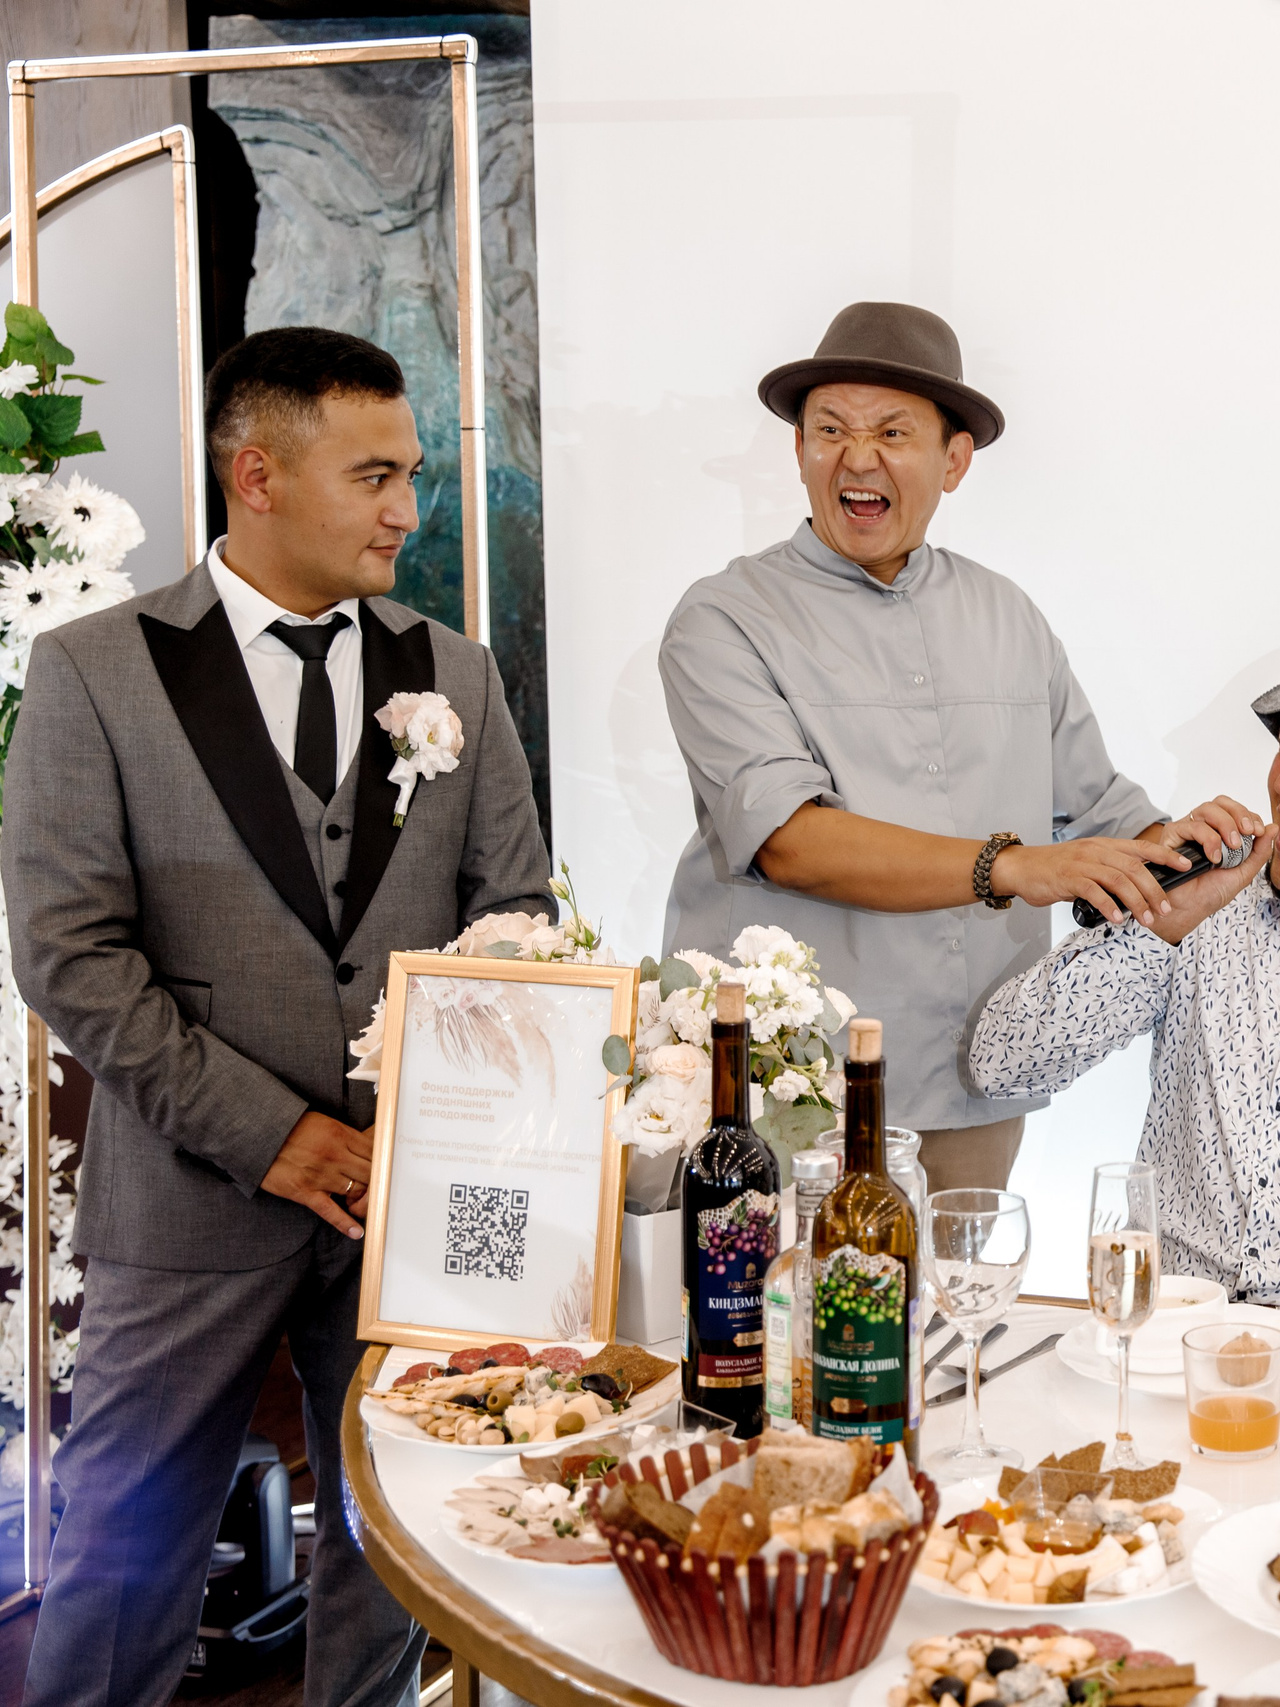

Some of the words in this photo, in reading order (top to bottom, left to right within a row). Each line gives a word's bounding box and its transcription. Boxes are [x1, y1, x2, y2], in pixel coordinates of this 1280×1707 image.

[421, 1081, 450, 1094] Фонд
[452, 1085, 515, 1099] поддержки
[420, 1095, 492, 1110] сегодняшних
[419, 1108, 496, 1123] молодоженов
[480, 1157, 509, 1168] нашй
[727, 1278, 764, 1290] Muzara
[860, 1356, 901, 1374] ДОЛИНА
